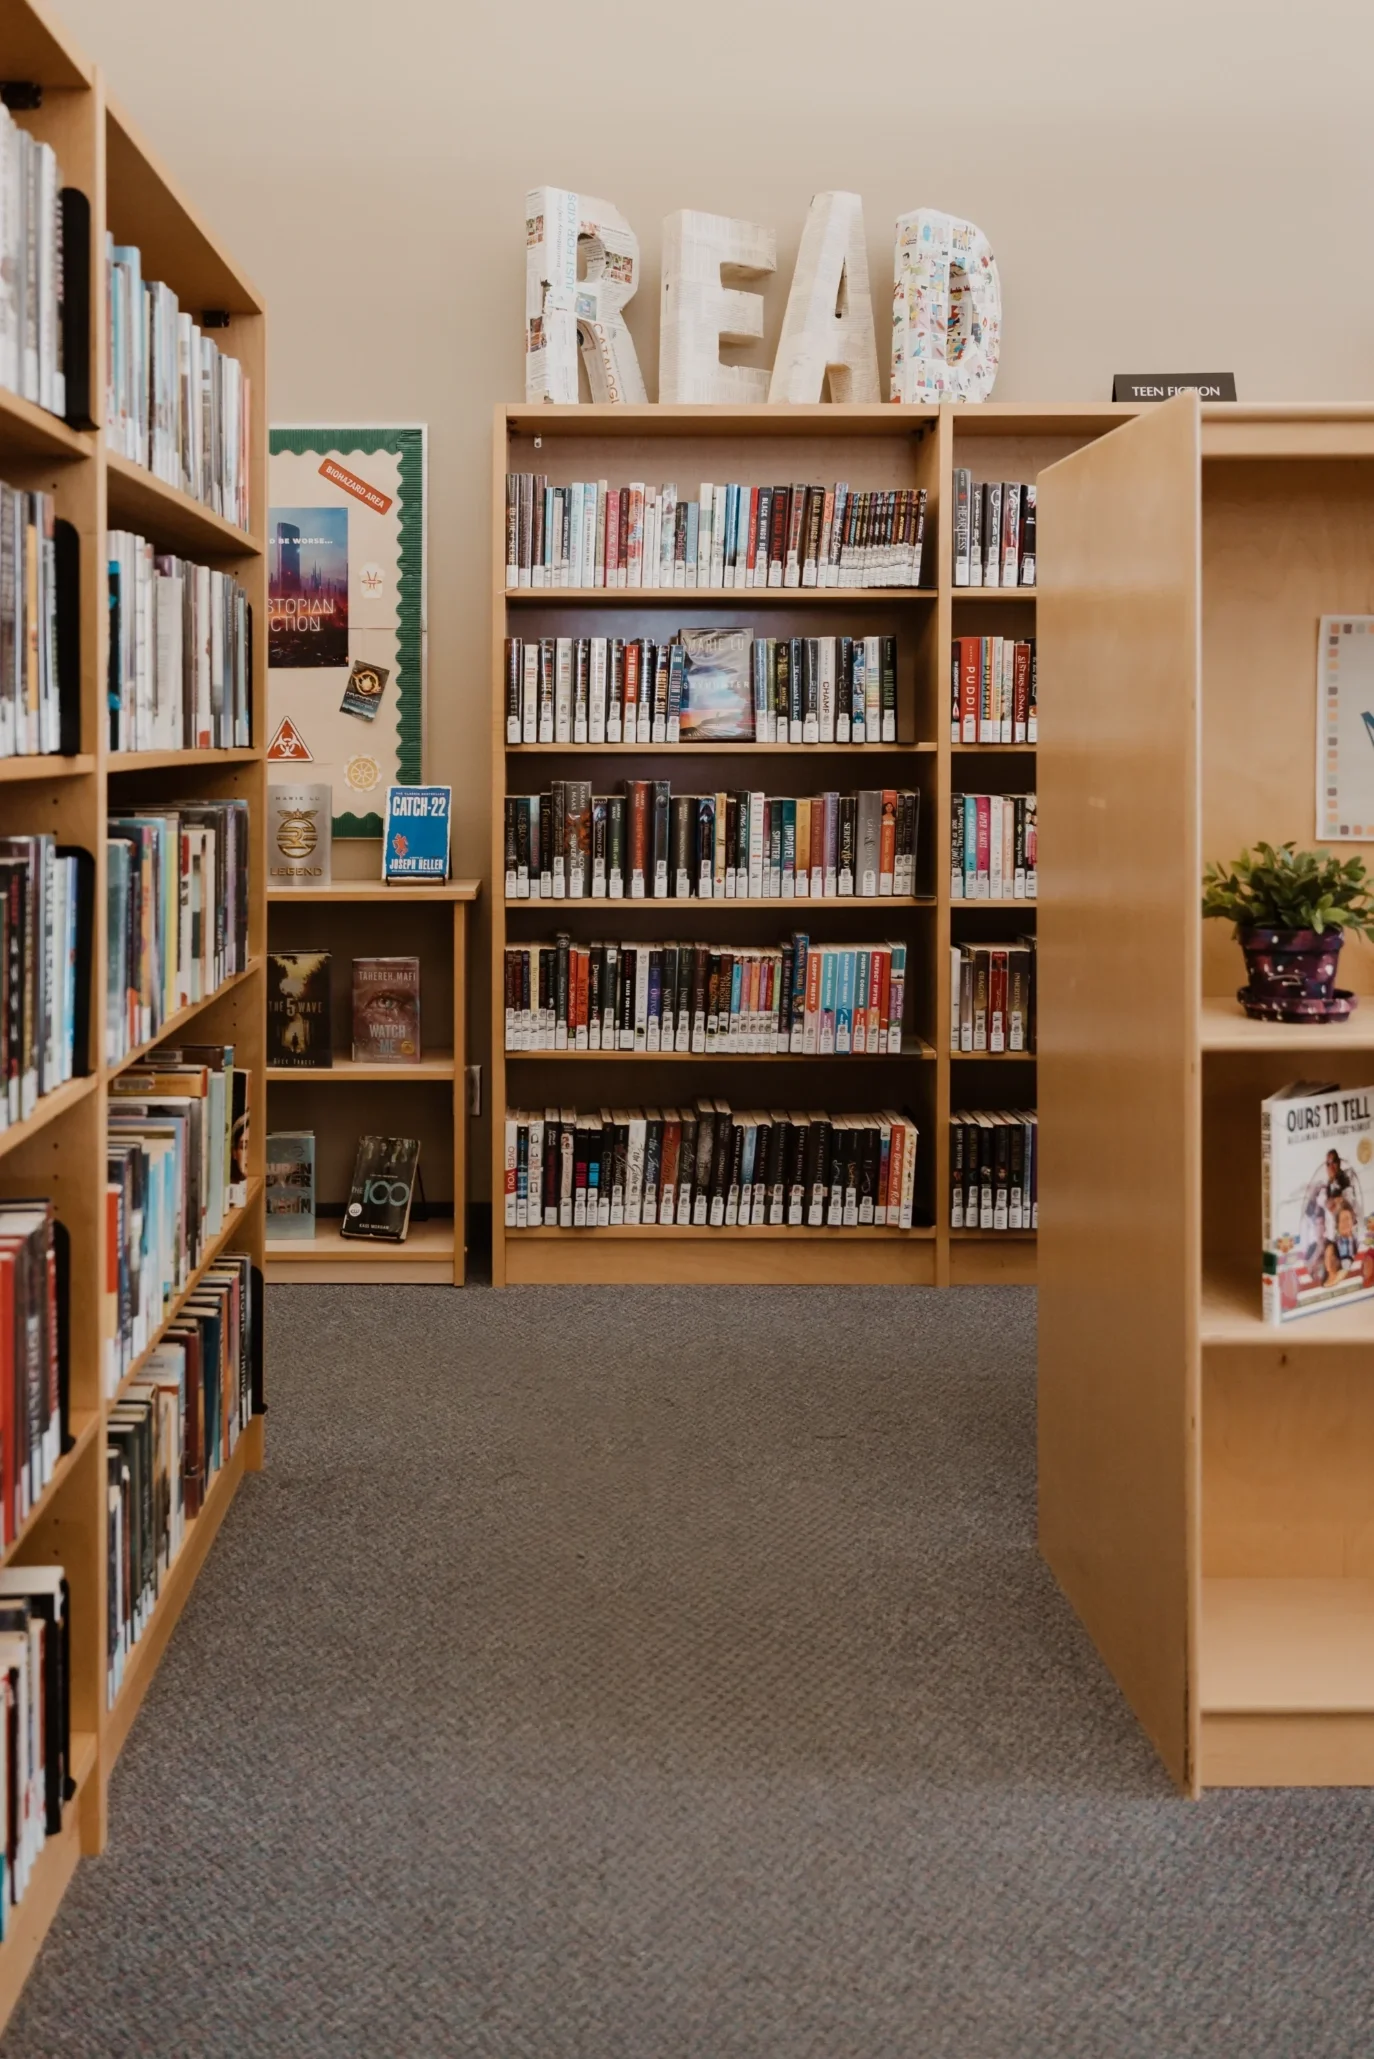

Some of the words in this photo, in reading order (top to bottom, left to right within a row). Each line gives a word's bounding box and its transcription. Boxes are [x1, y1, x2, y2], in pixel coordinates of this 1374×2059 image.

[567, 194, 576, 224] KIDS
[566, 229, 575, 255] FOR
[565, 261, 574, 293] JUST
[525, 186, 1003, 405] READ
[593, 323, 620, 404] CATALOG
[1131, 386, 1164, 397] TEEN
[326, 465, 365, 495] BIOHAZARD
[365, 492, 385, 509] AREA
[813, 495, 821, 513] GOLD
[760, 520, 768, 540] WINGS
[775, 513, 783, 534] SKIES
[811, 516, 819, 539] WINGS
[834, 518, 842, 532] What
[954, 506, 969, 550] HEARTLESS
[759, 543, 766, 551] BE
[831, 542, 840, 559] Carry
[670, 670, 681, 693] RETURN
[1017, 656, 1026, 686] SISTERS
[656, 670, 667, 699] FUGITIVE
[884, 670, 894, 706] WILDCARD
[966, 666, 975, 711] PUDDI
[655, 702, 665, 713] SIX
[392, 796, 446, 817] CATCH-22
[772, 831, 780, 859] SHATTER
[784, 825, 794, 859] UNRAVEL
[843, 822, 851, 853] SERPENT
[269, 867, 323, 876] LEGEND
[389, 859, 416, 870] JOSEPH
[418, 858, 443, 870] HELLER
[358, 971, 393, 982] TAHEREH
[396, 971, 416, 981] MAFI
[269, 1001, 283, 1012] THE
[299, 1002, 322, 1013] WAVE
[650, 988, 658, 1016] OUTCAS
[709, 974, 718, 1015] FALCONER
[369, 1023, 406, 1039] WATCH
[379, 1039, 396, 1053] ME
[1287, 1105, 1321, 1133] OURS
[1324, 1102, 1339, 1126] TO
[1341, 1096, 1371, 1122] TELL
[649, 1139, 659, 1150] the
[760, 1126, 768, 1159] SHADOW
[717, 1149, 725, 1184] MIDNIGHT
[363, 1179, 410, 1206] 100
